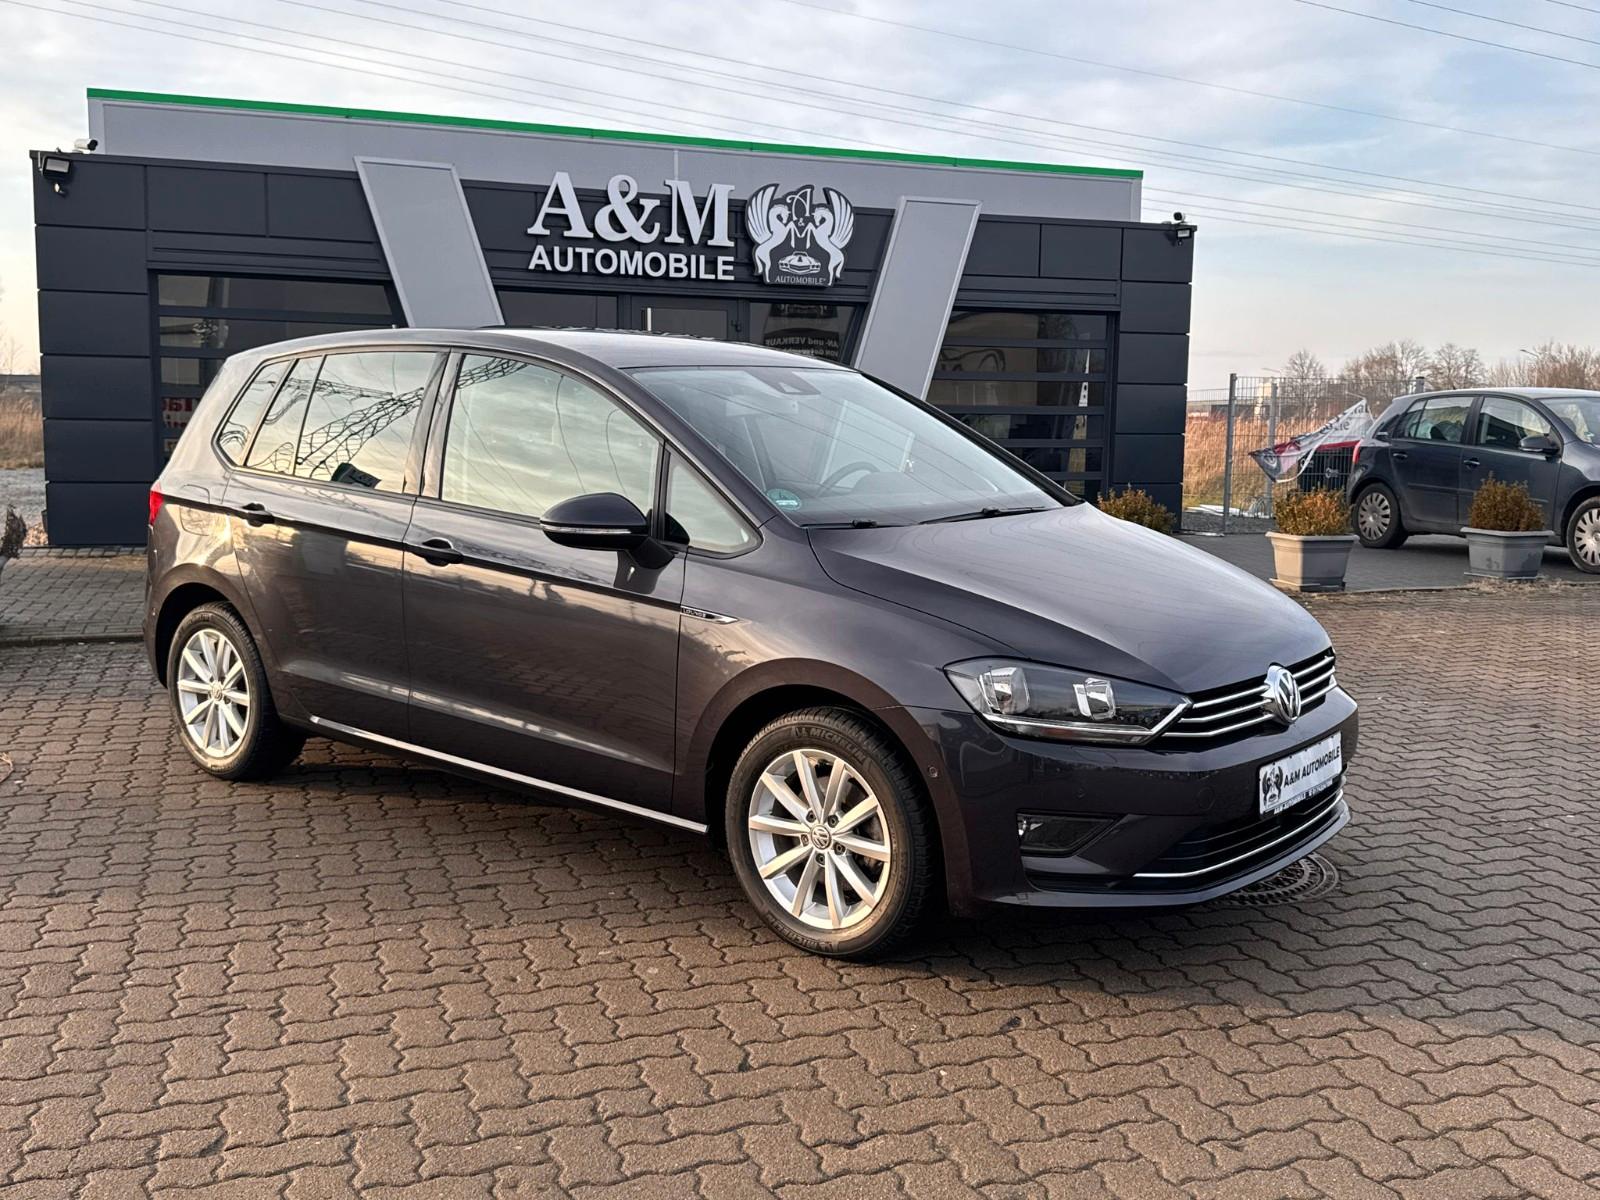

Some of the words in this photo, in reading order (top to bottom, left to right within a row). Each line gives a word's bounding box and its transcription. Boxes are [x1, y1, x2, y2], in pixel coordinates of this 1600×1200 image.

[527, 171, 735, 247] A&M
[528, 245, 735, 281] AUTOMOBILE
[1283, 768, 1301, 788] A&M
[1301, 746, 1340, 779] AUTOMOBILE
